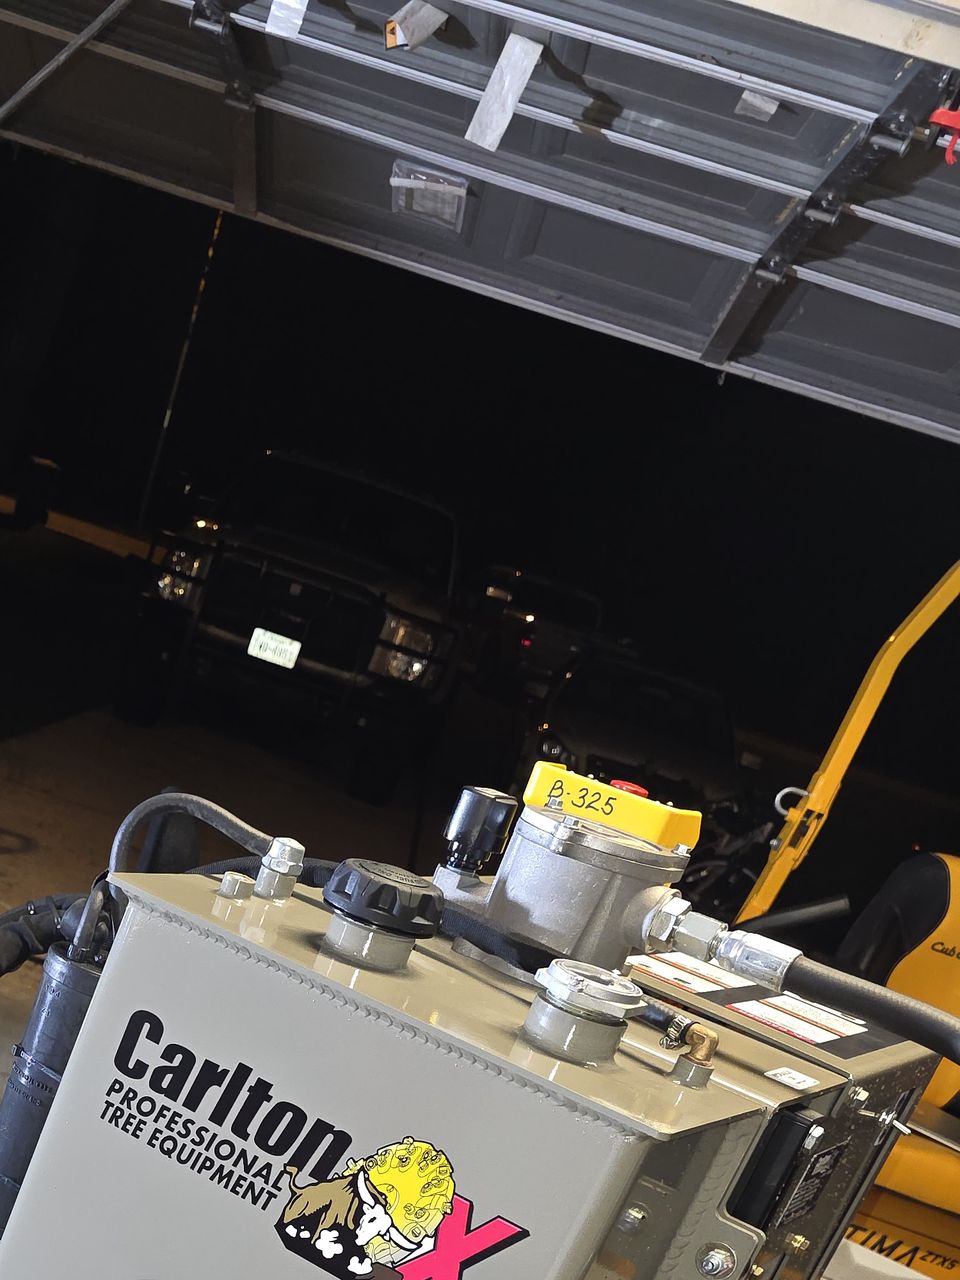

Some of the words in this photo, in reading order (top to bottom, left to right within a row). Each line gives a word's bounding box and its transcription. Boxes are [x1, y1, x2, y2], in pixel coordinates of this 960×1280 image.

[547, 779, 617, 816] B-325
[930, 941, 956, 957] Cub
[105, 1078, 289, 1192] PROFESSIONAL
[113, 1009, 353, 1183] Carlton
[99, 1100, 144, 1140] TREE
[146, 1127, 278, 1212] EQUIPMENT
[845, 1223, 920, 1267] TIMA
